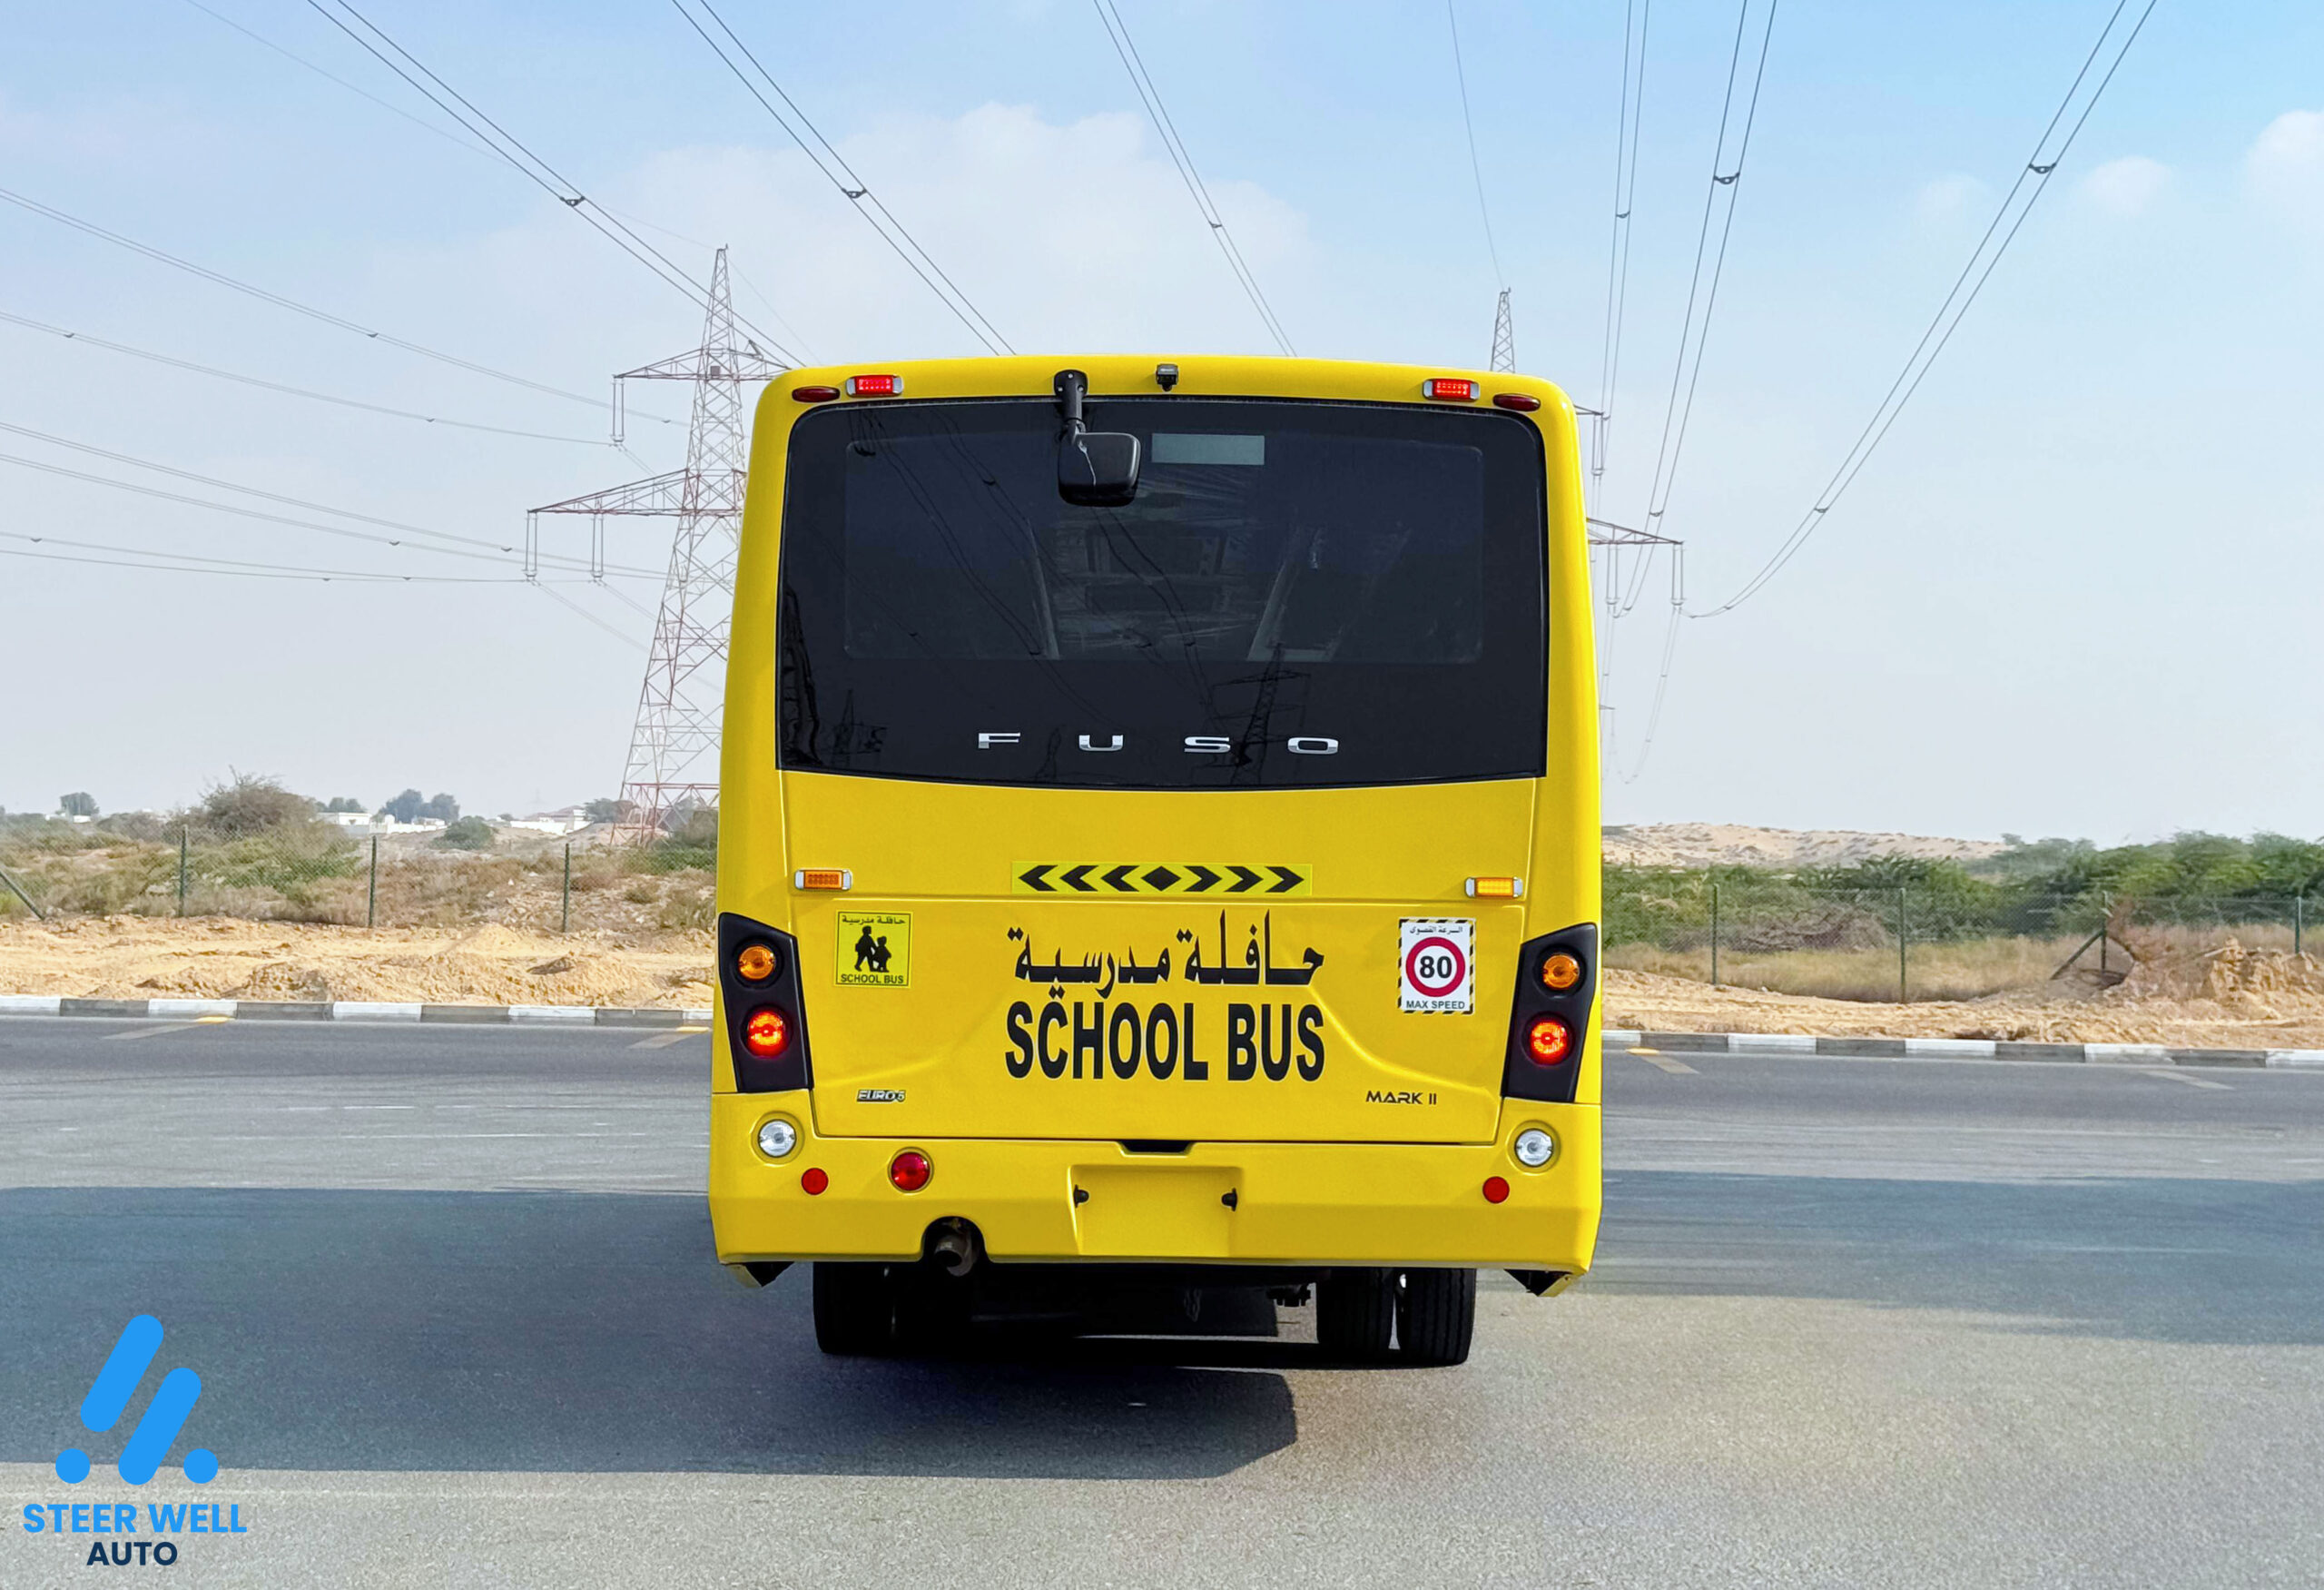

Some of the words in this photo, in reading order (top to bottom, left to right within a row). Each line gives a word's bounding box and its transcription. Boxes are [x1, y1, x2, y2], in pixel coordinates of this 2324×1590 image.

[978, 732, 1339, 755] FUSO
[1177, 908, 1324, 985] حافلة
[1007, 926, 1171, 999] مدرسية
[1419, 955, 1452, 979] 80
[841, 973, 881, 983] SCHOOL
[883, 975, 904, 984] BUS
[1405, 1000, 1429, 1009] MAX
[1431, 1001, 1465, 1010] SPEED
[1005, 1001, 1209, 1081] SCHOOL
[1227, 1002, 1325, 1082] BUS
[1365, 1090, 1423, 1104] MARK
